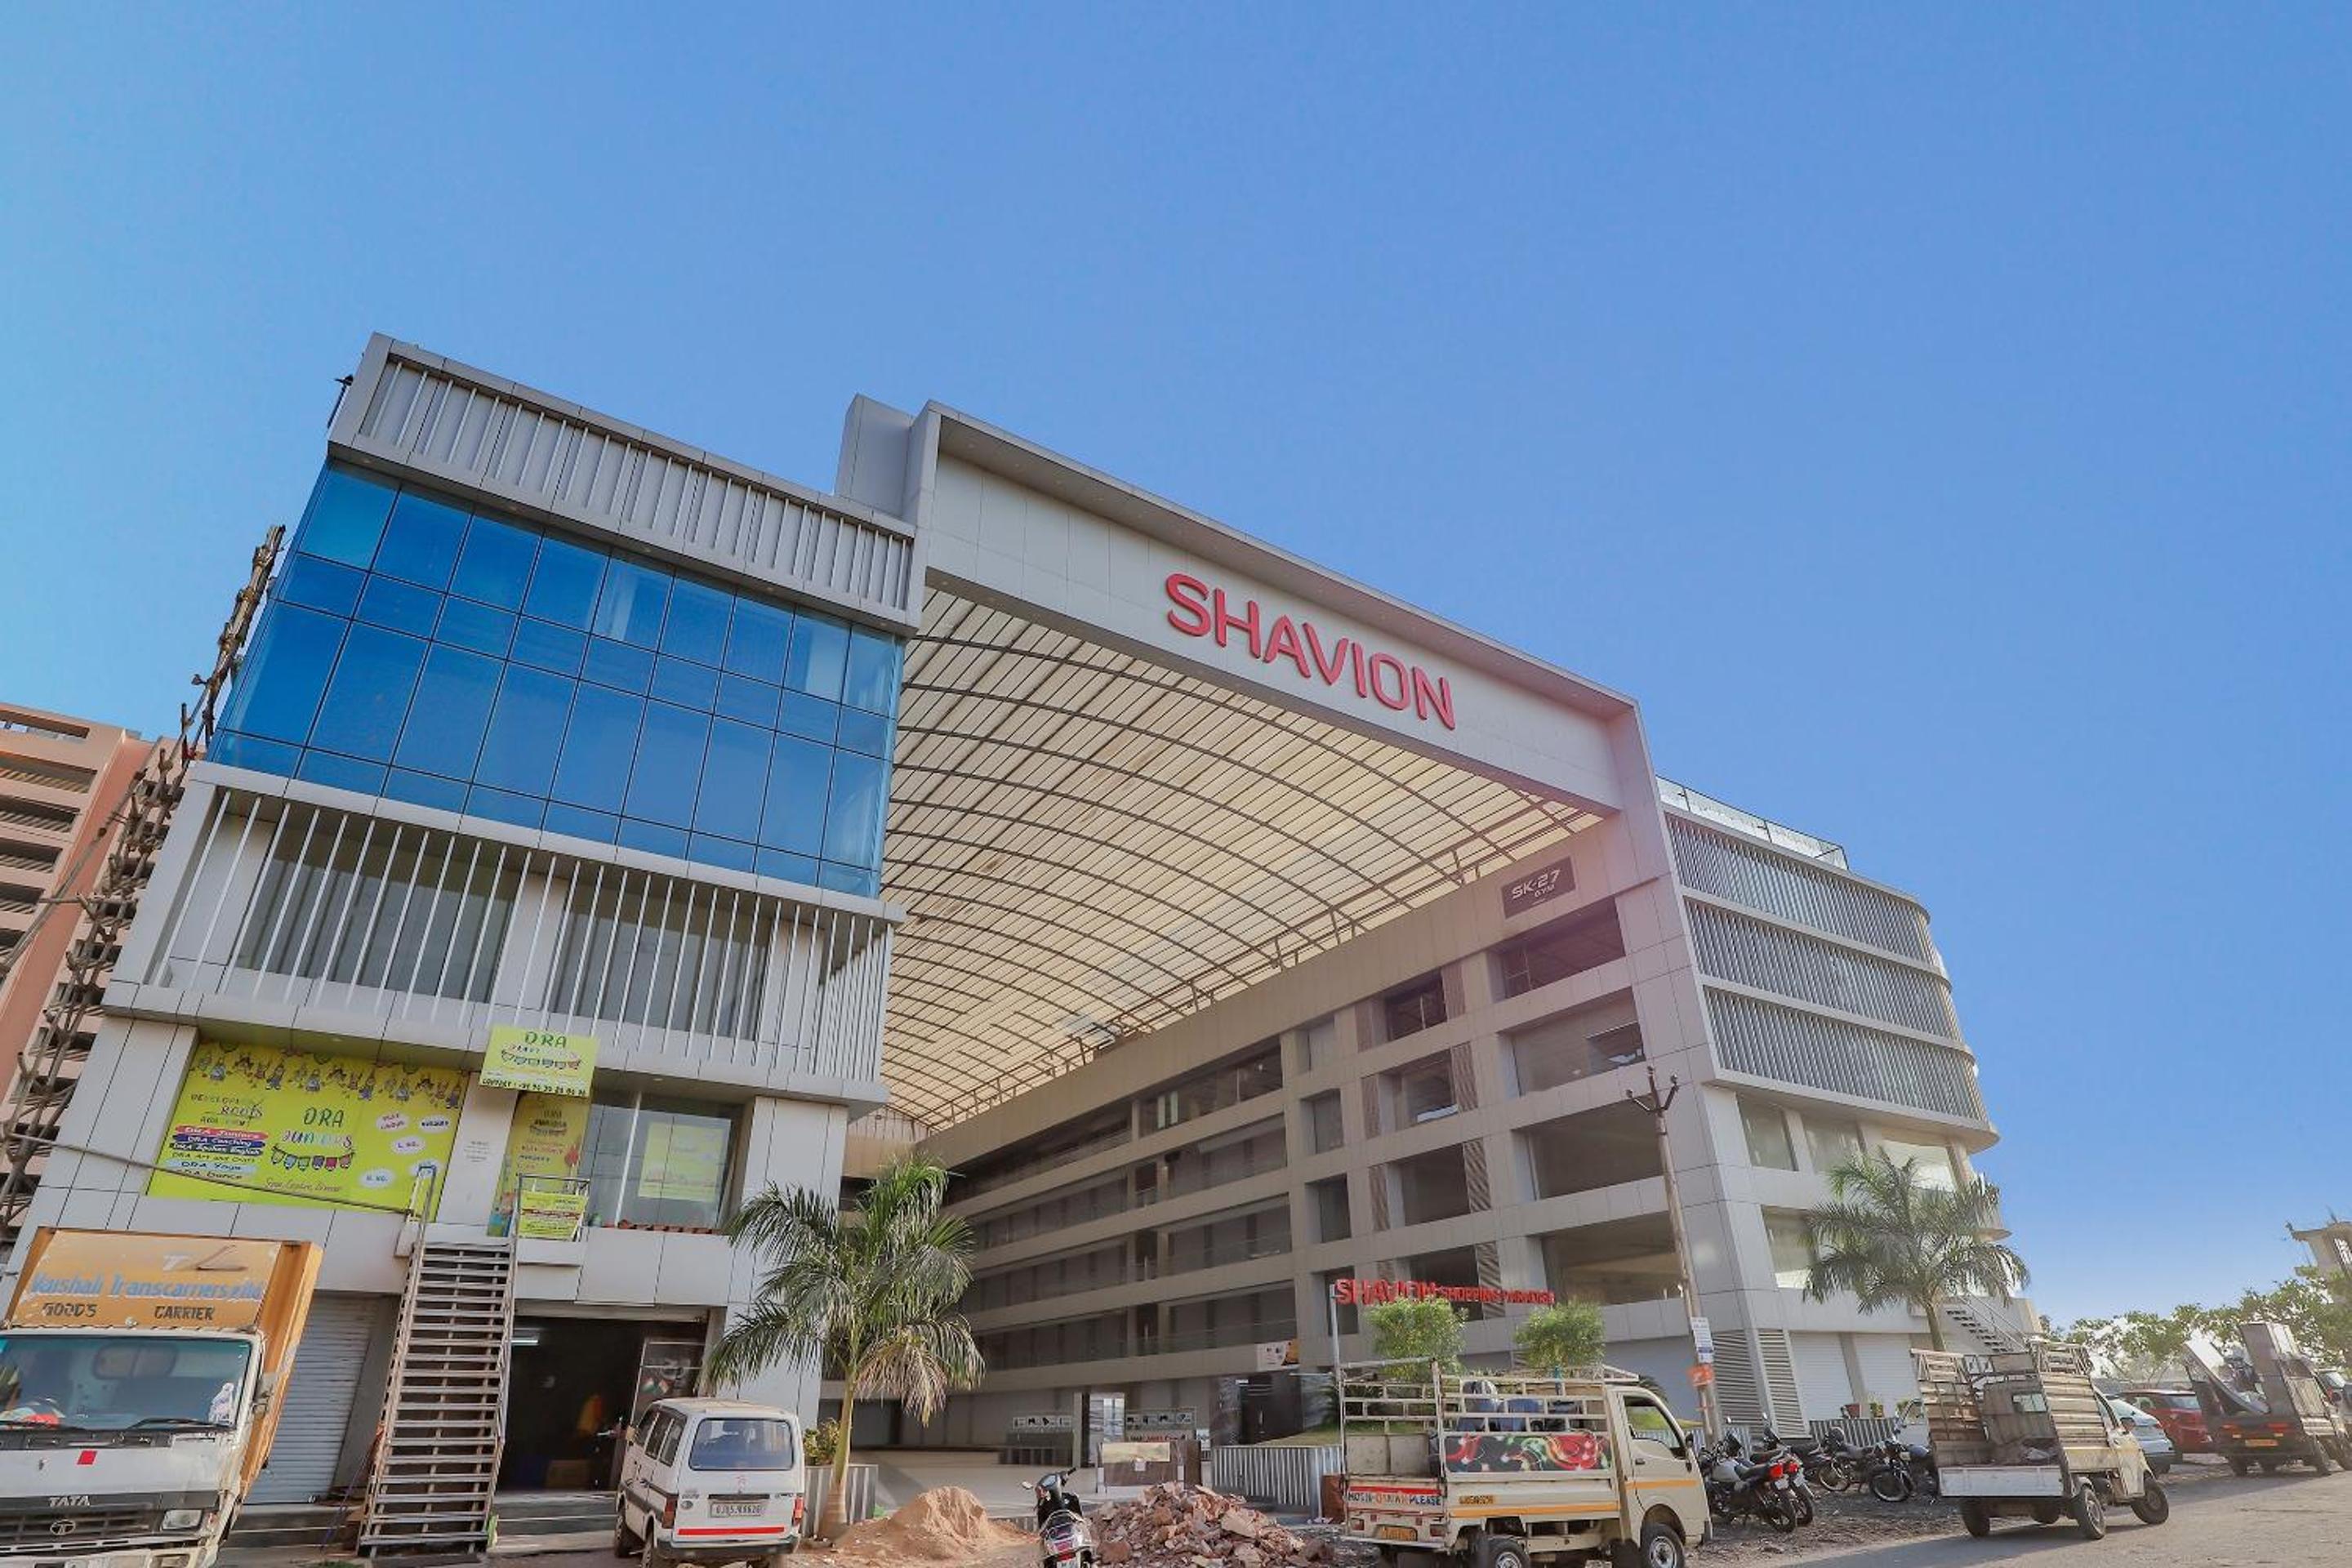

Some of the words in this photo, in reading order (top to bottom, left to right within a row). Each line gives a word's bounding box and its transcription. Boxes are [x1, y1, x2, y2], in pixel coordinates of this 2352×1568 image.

[1165, 573, 1455, 730] SHAVION
[1512, 869, 1561, 899] SK-27
[42, 1303, 97, 1317] GOODS
[154, 1305, 214, 1321] CARRIER
[49, 1495, 90, 1508] TATA
[1410, 1494, 1441, 1507] PLEASE
